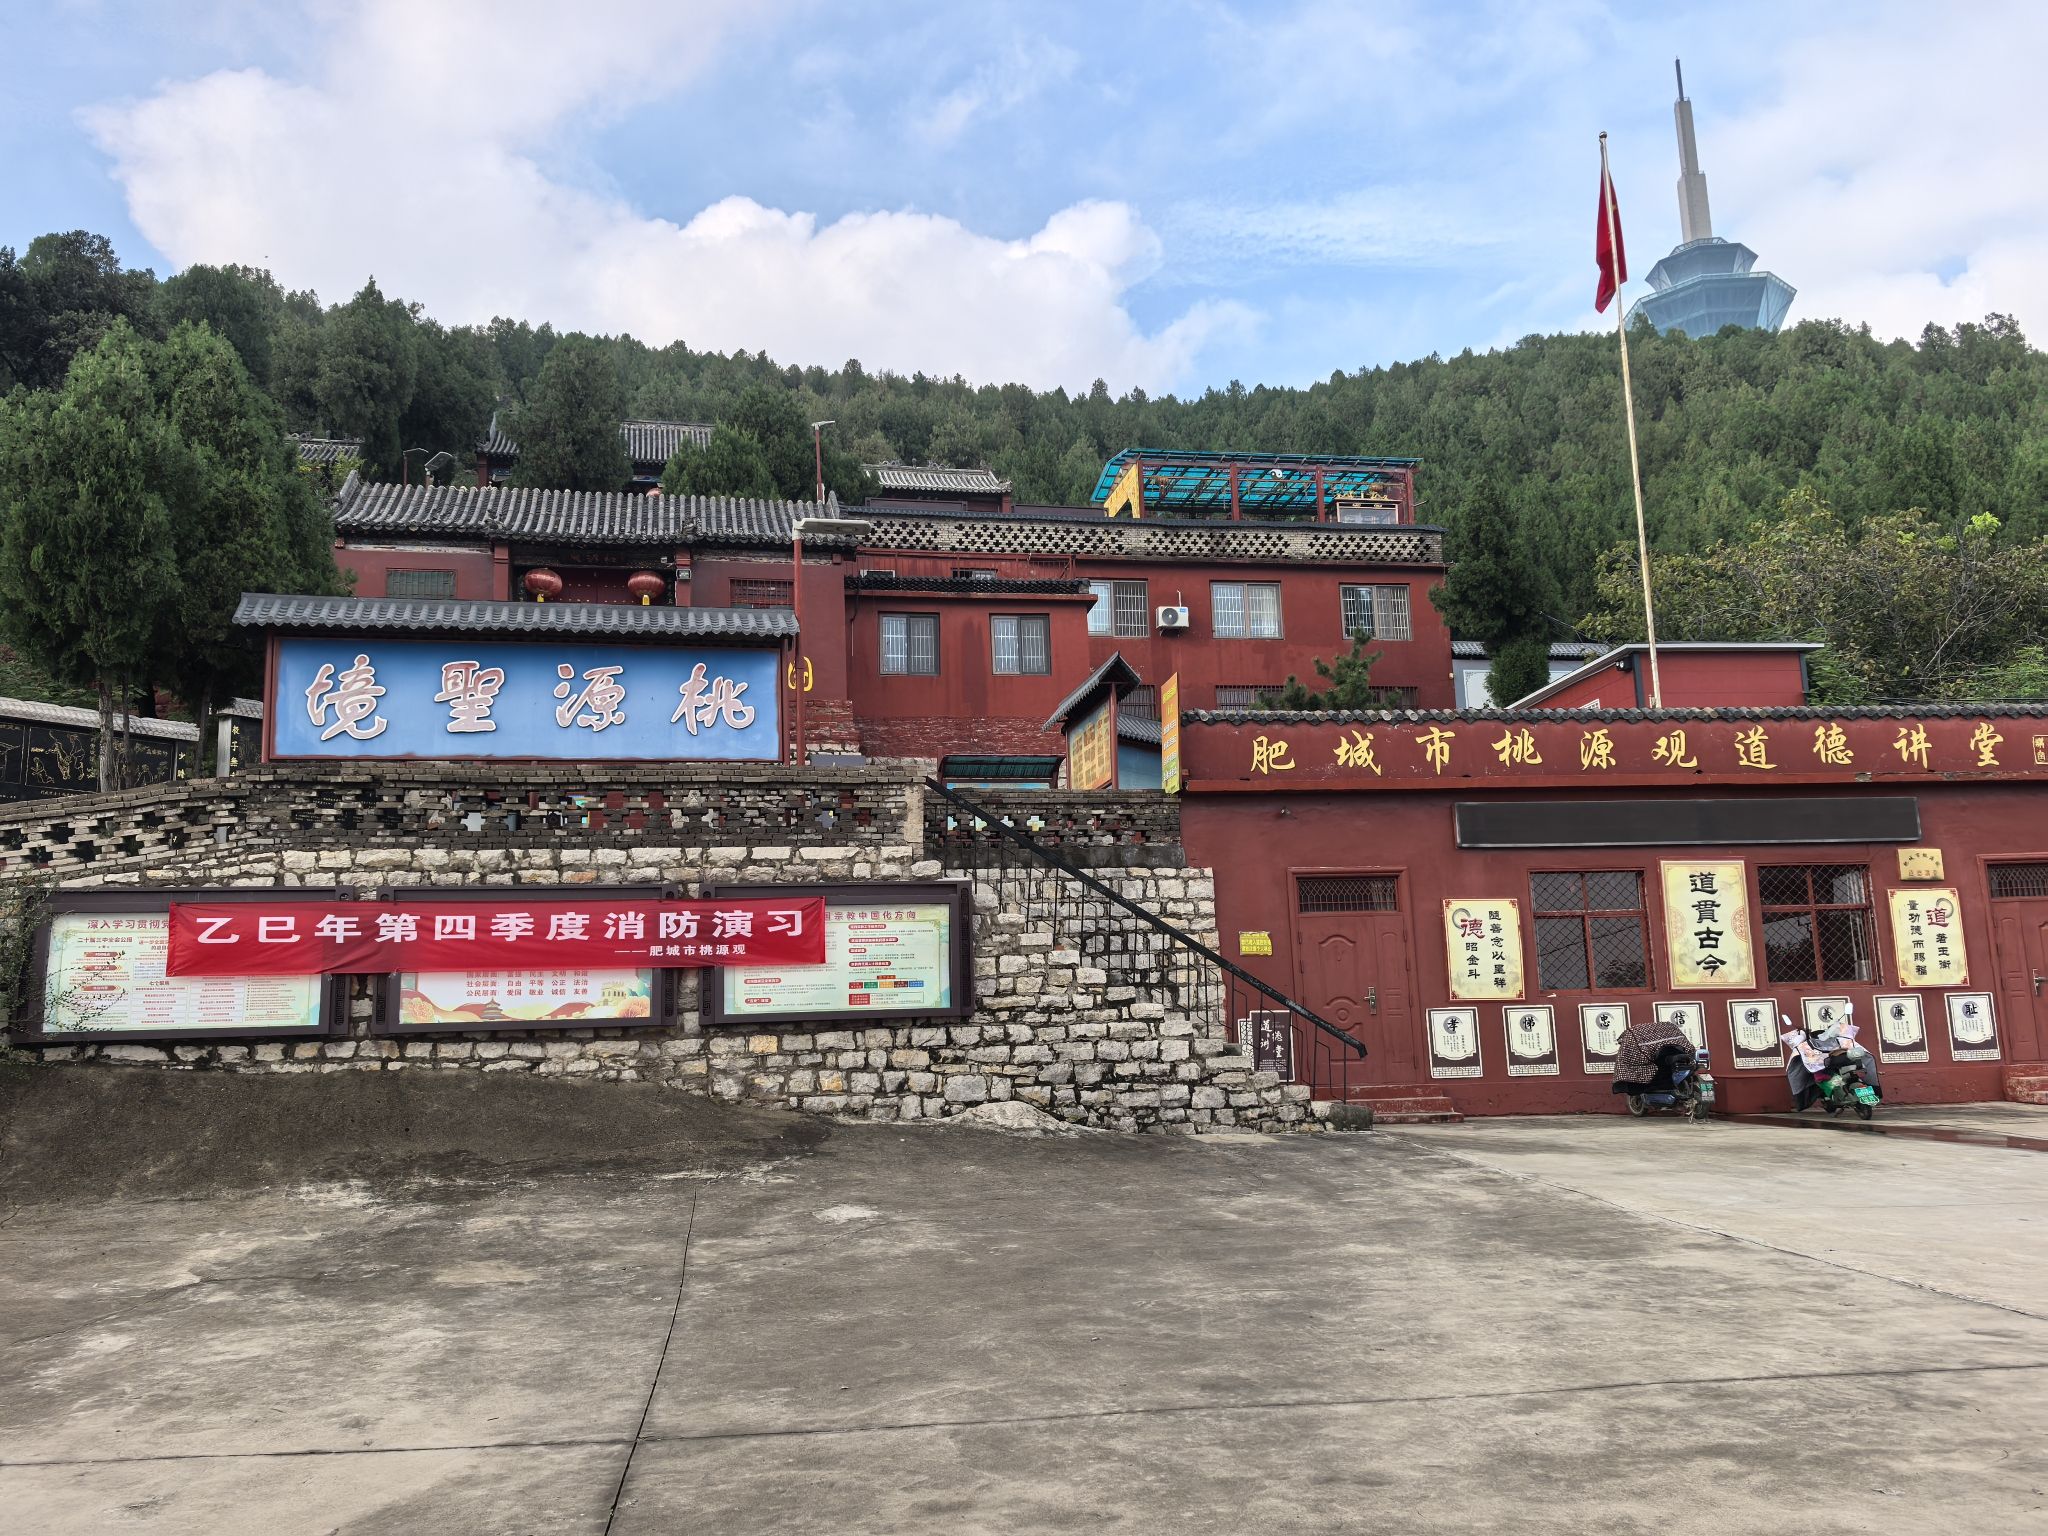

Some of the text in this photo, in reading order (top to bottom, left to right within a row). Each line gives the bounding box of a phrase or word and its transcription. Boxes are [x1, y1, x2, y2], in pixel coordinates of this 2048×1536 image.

[1251, 725, 2005, 775] 肥城市桃源观道德讲堂
[196, 910, 803, 945] 乙巳年第四季度消防演习
[1689, 872, 1727, 977] 道貫古今
[1447, 1018, 1460, 1032] 孝
[1522, 1016, 1536, 1030] 悌
[1600, 1014, 1611, 1029] 忠
[1674, 1012, 1686, 1026] 信
